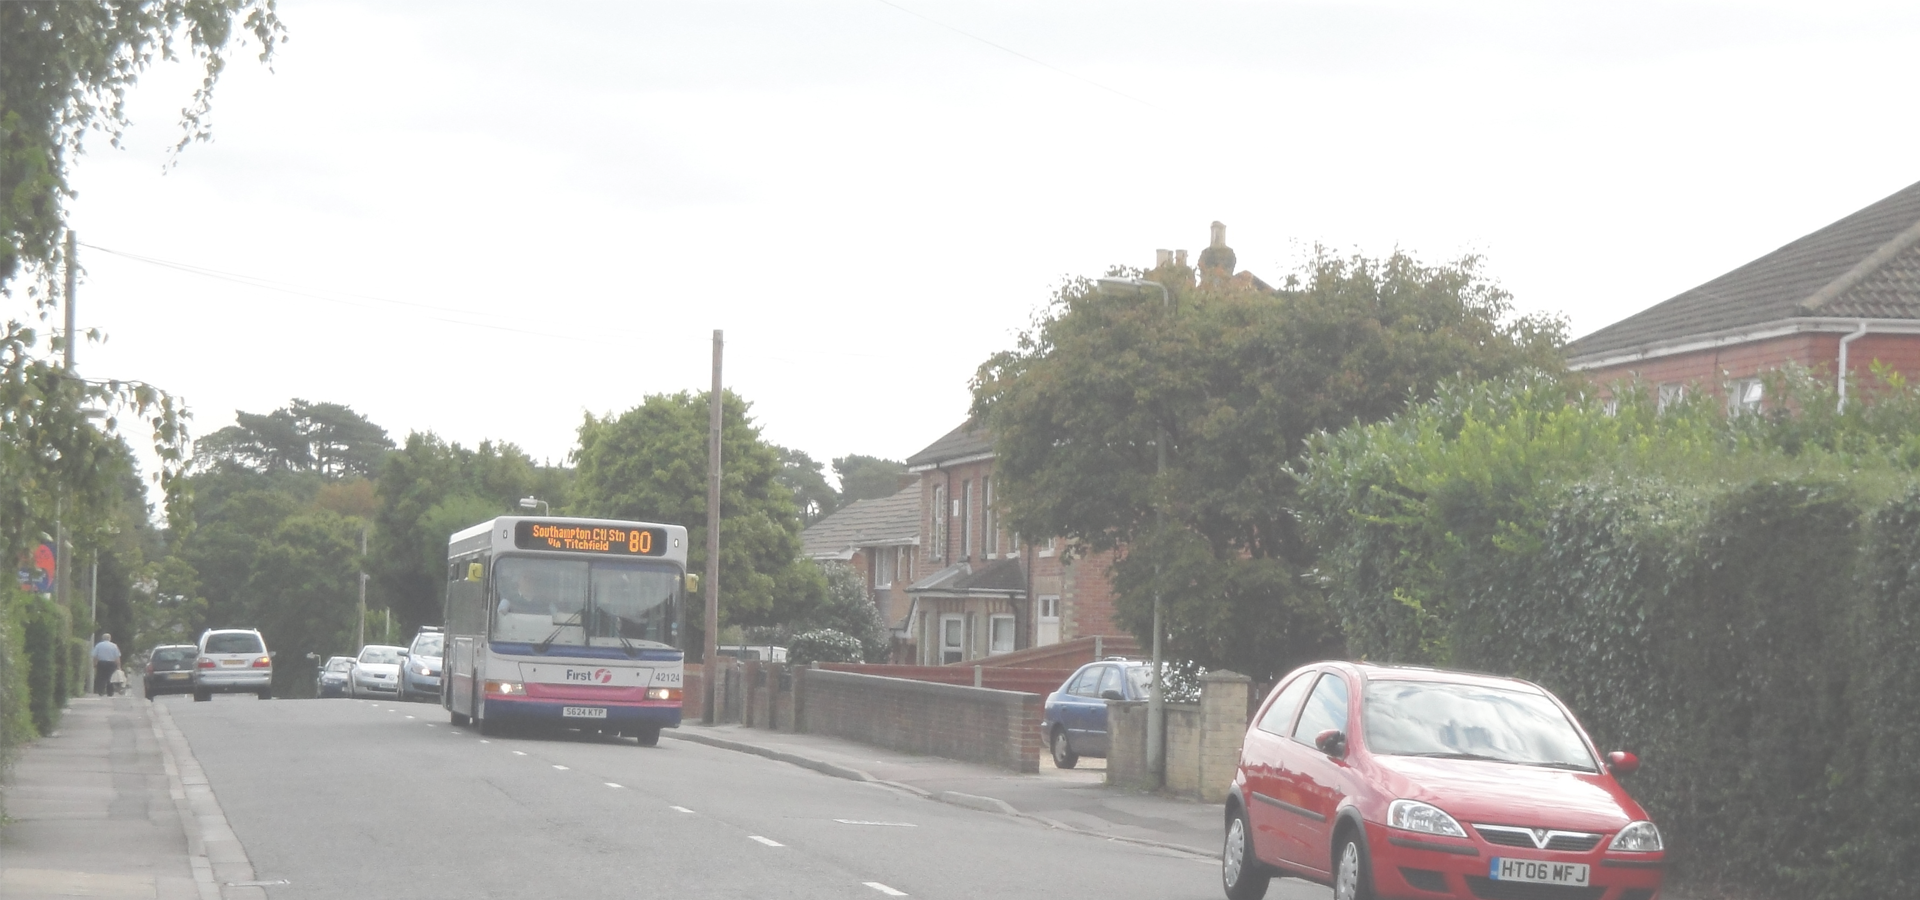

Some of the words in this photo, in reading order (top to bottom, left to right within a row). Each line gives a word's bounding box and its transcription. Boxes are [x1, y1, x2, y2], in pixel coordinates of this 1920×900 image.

[533, 525, 591, 540] Southampton
[608, 530, 625, 542] Stn
[564, 538, 609, 551] Titchfield
[629, 530, 651, 553] 80
[566, 669, 592, 681] First
[655, 672, 680, 682] 42124
[566, 708, 586, 716] S624
[1502, 860, 1547, 879] HT06
[1552, 864, 1586, 882] MFJ
